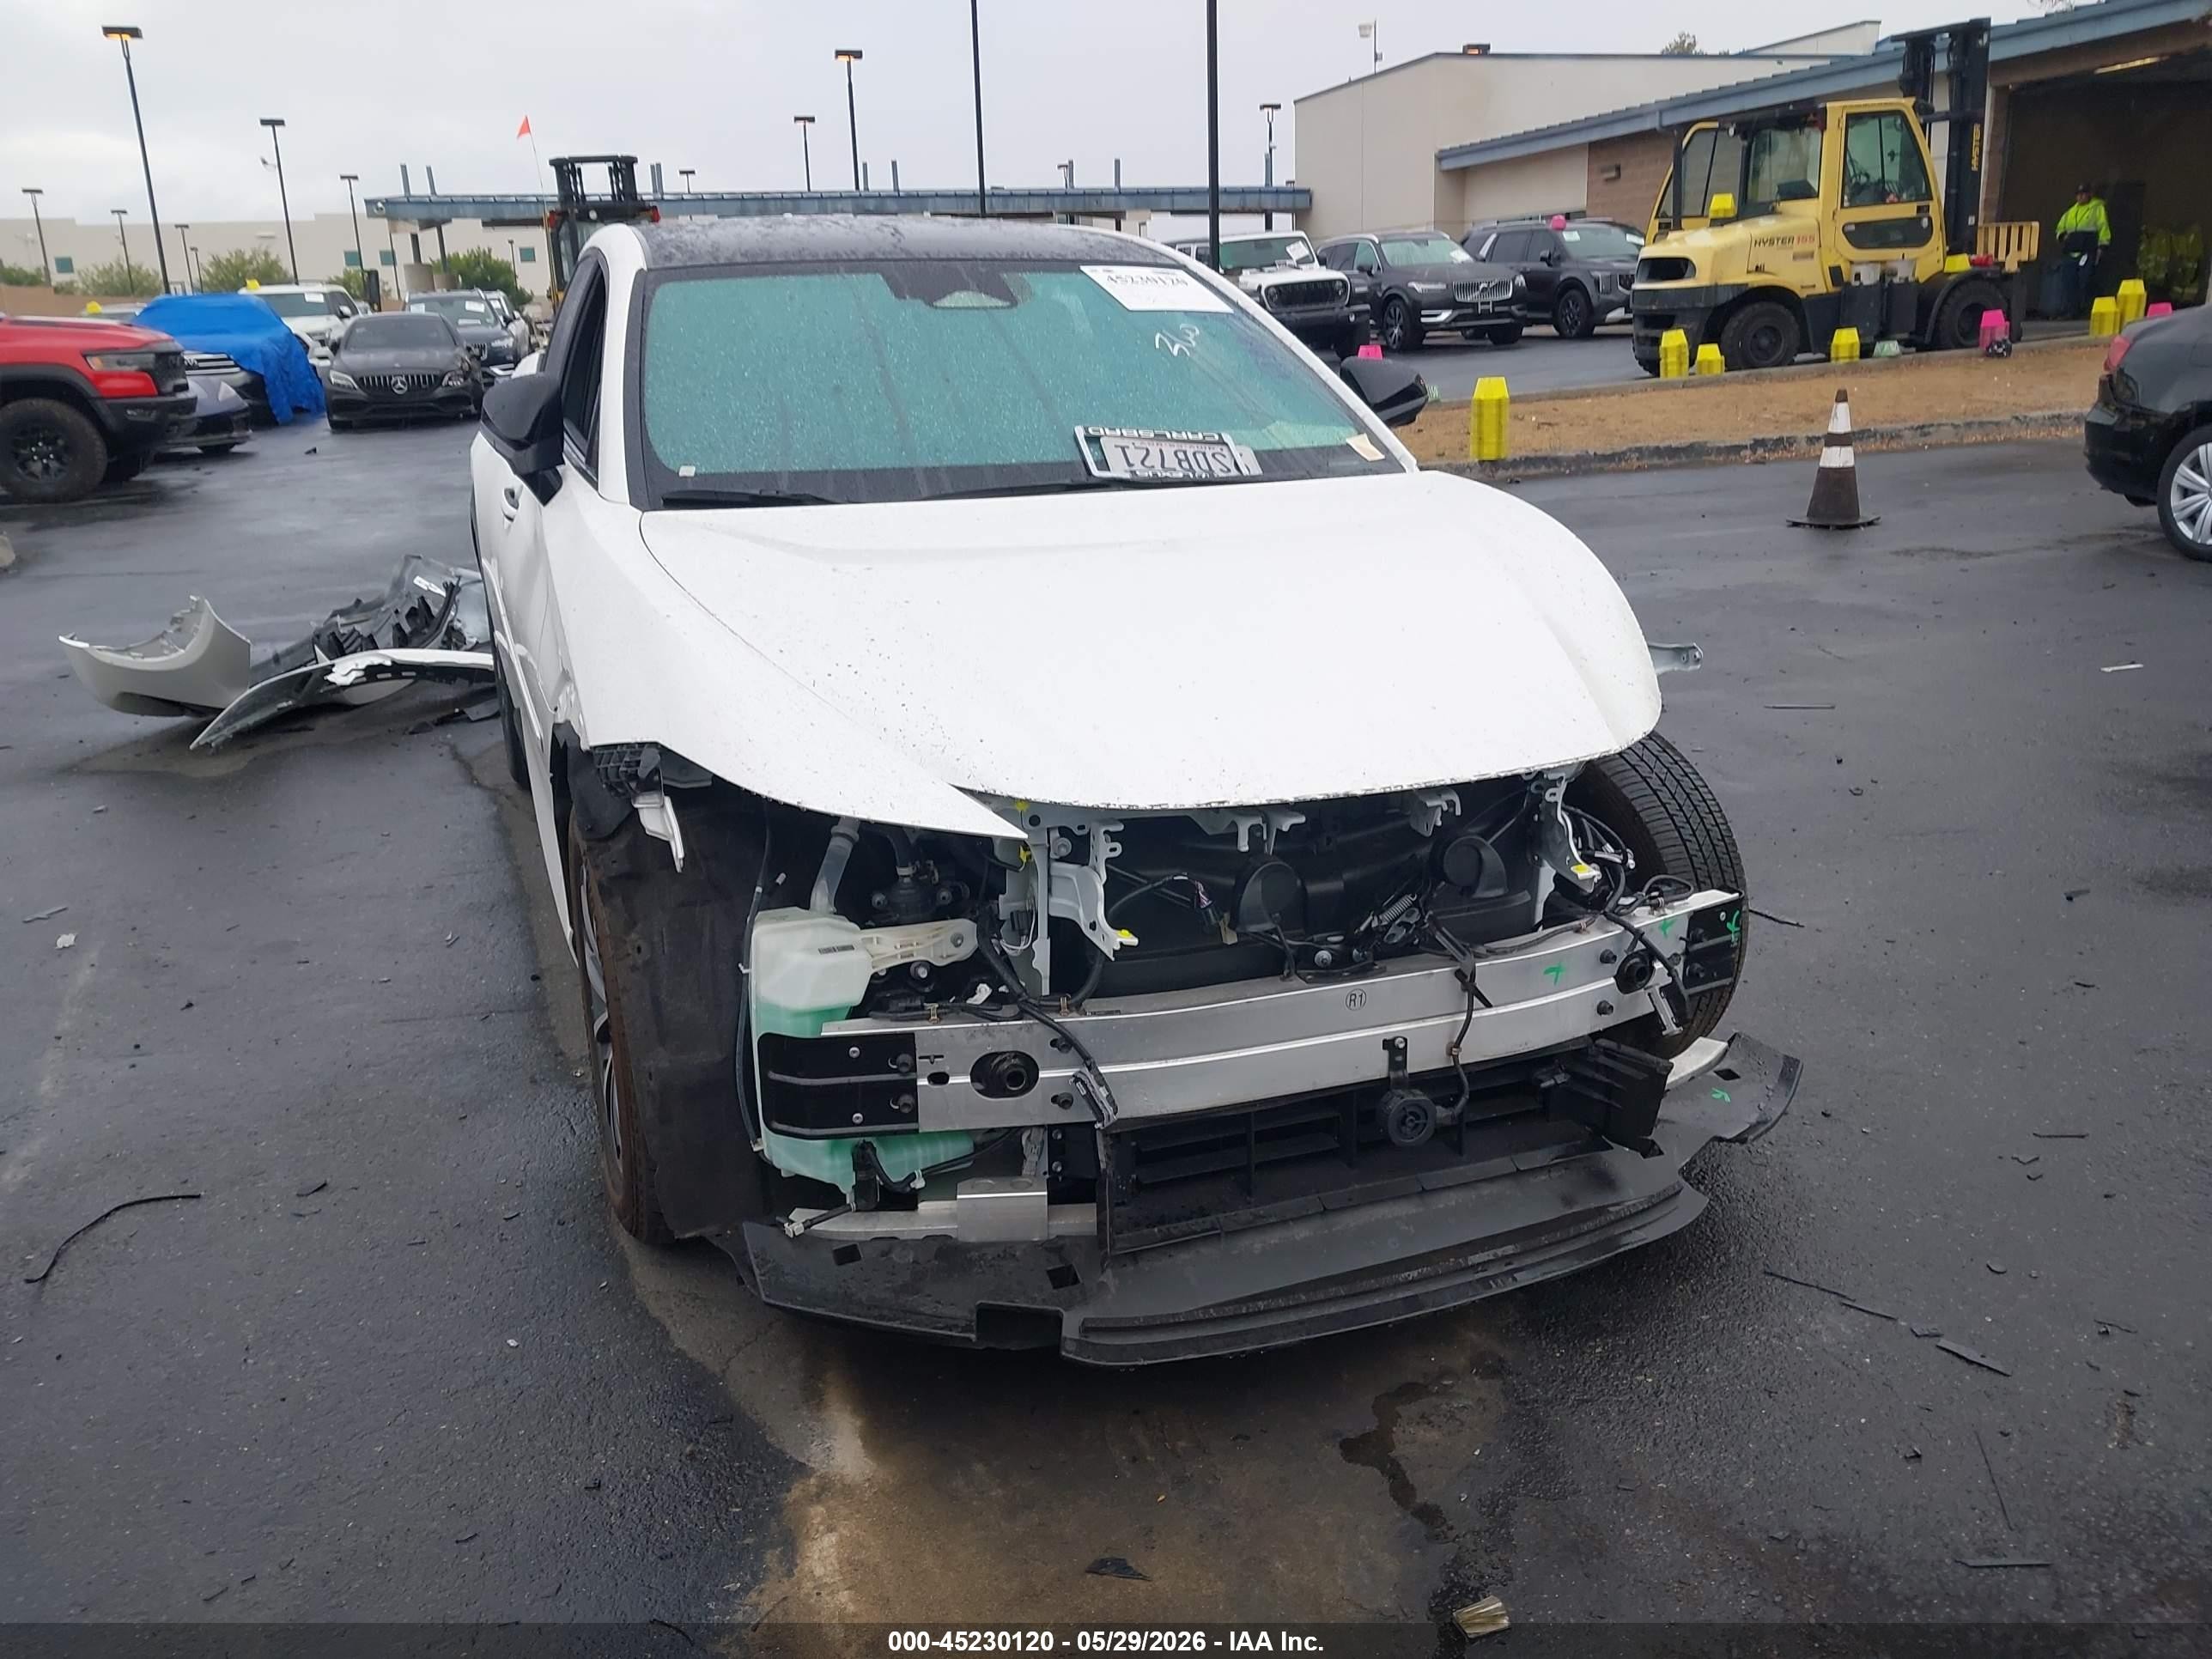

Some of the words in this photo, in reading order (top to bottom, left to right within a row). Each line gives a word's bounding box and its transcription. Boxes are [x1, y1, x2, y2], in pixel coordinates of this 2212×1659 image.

[1753, 235, 1795, 247] HYSTER
[1087, 426, 1219, 441] CARLSBAD
[1348, 992, 1364, 1008] R1
